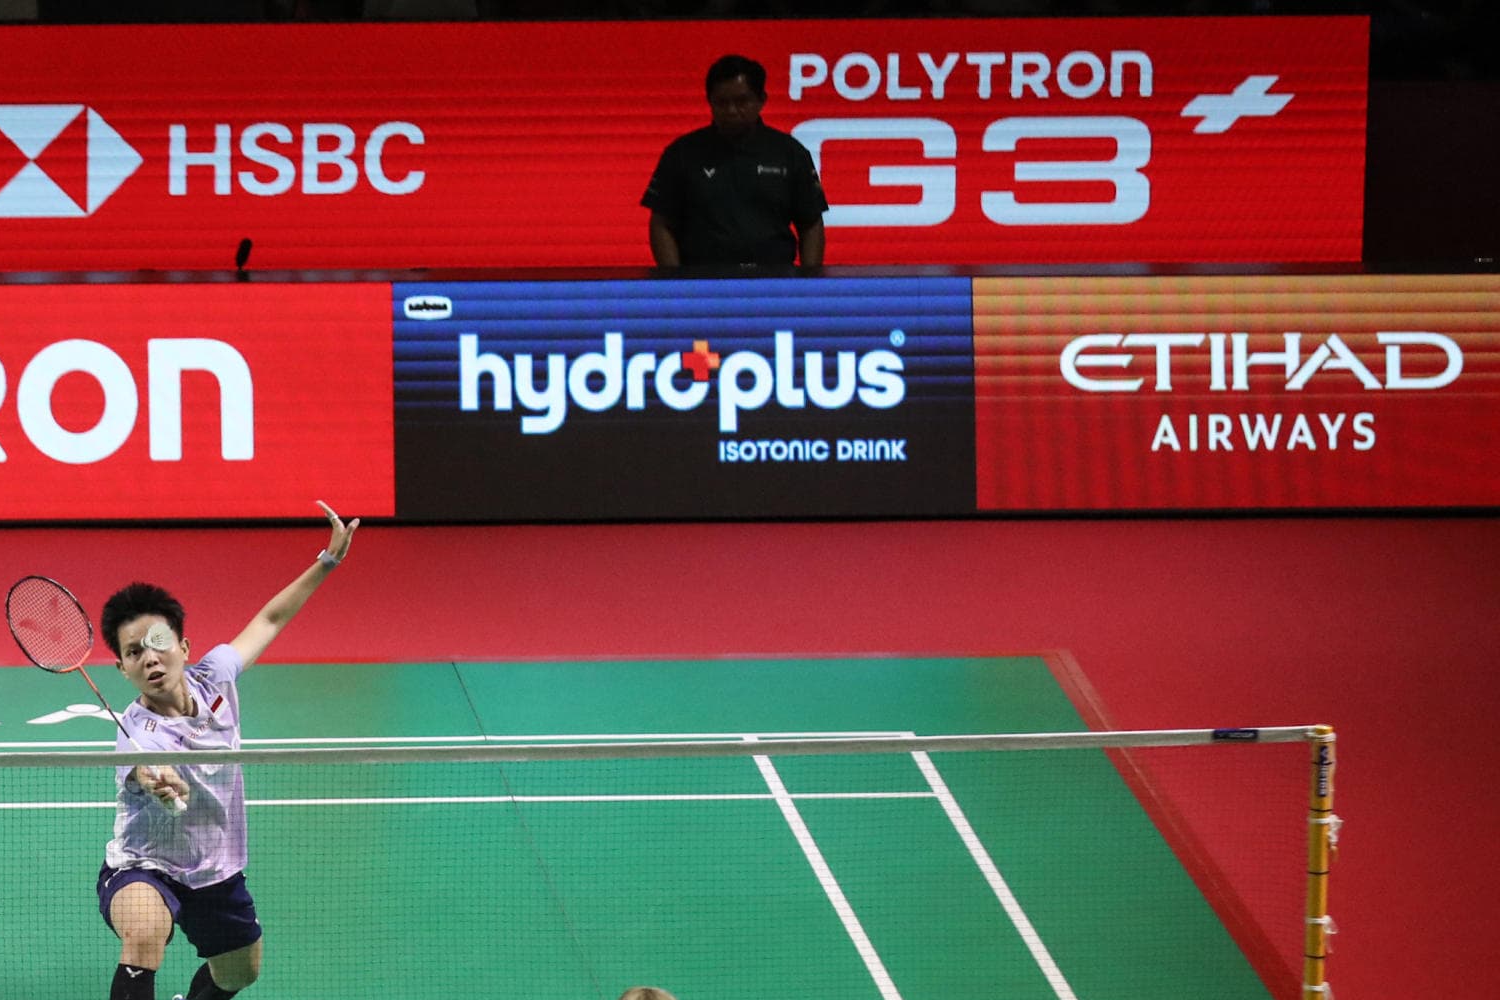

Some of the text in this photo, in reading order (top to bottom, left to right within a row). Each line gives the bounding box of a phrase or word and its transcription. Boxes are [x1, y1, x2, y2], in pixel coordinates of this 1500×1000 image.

[789, 50, 1154, 100] POLYTRON
[167, 121, 426, 196] HSBC
[1058, 331, 1465, 392] ETIHAD
[718, 439, 908, 463] ISOTONIC DRINK
[1151, 412, 1377, 452] AIRWAYS
